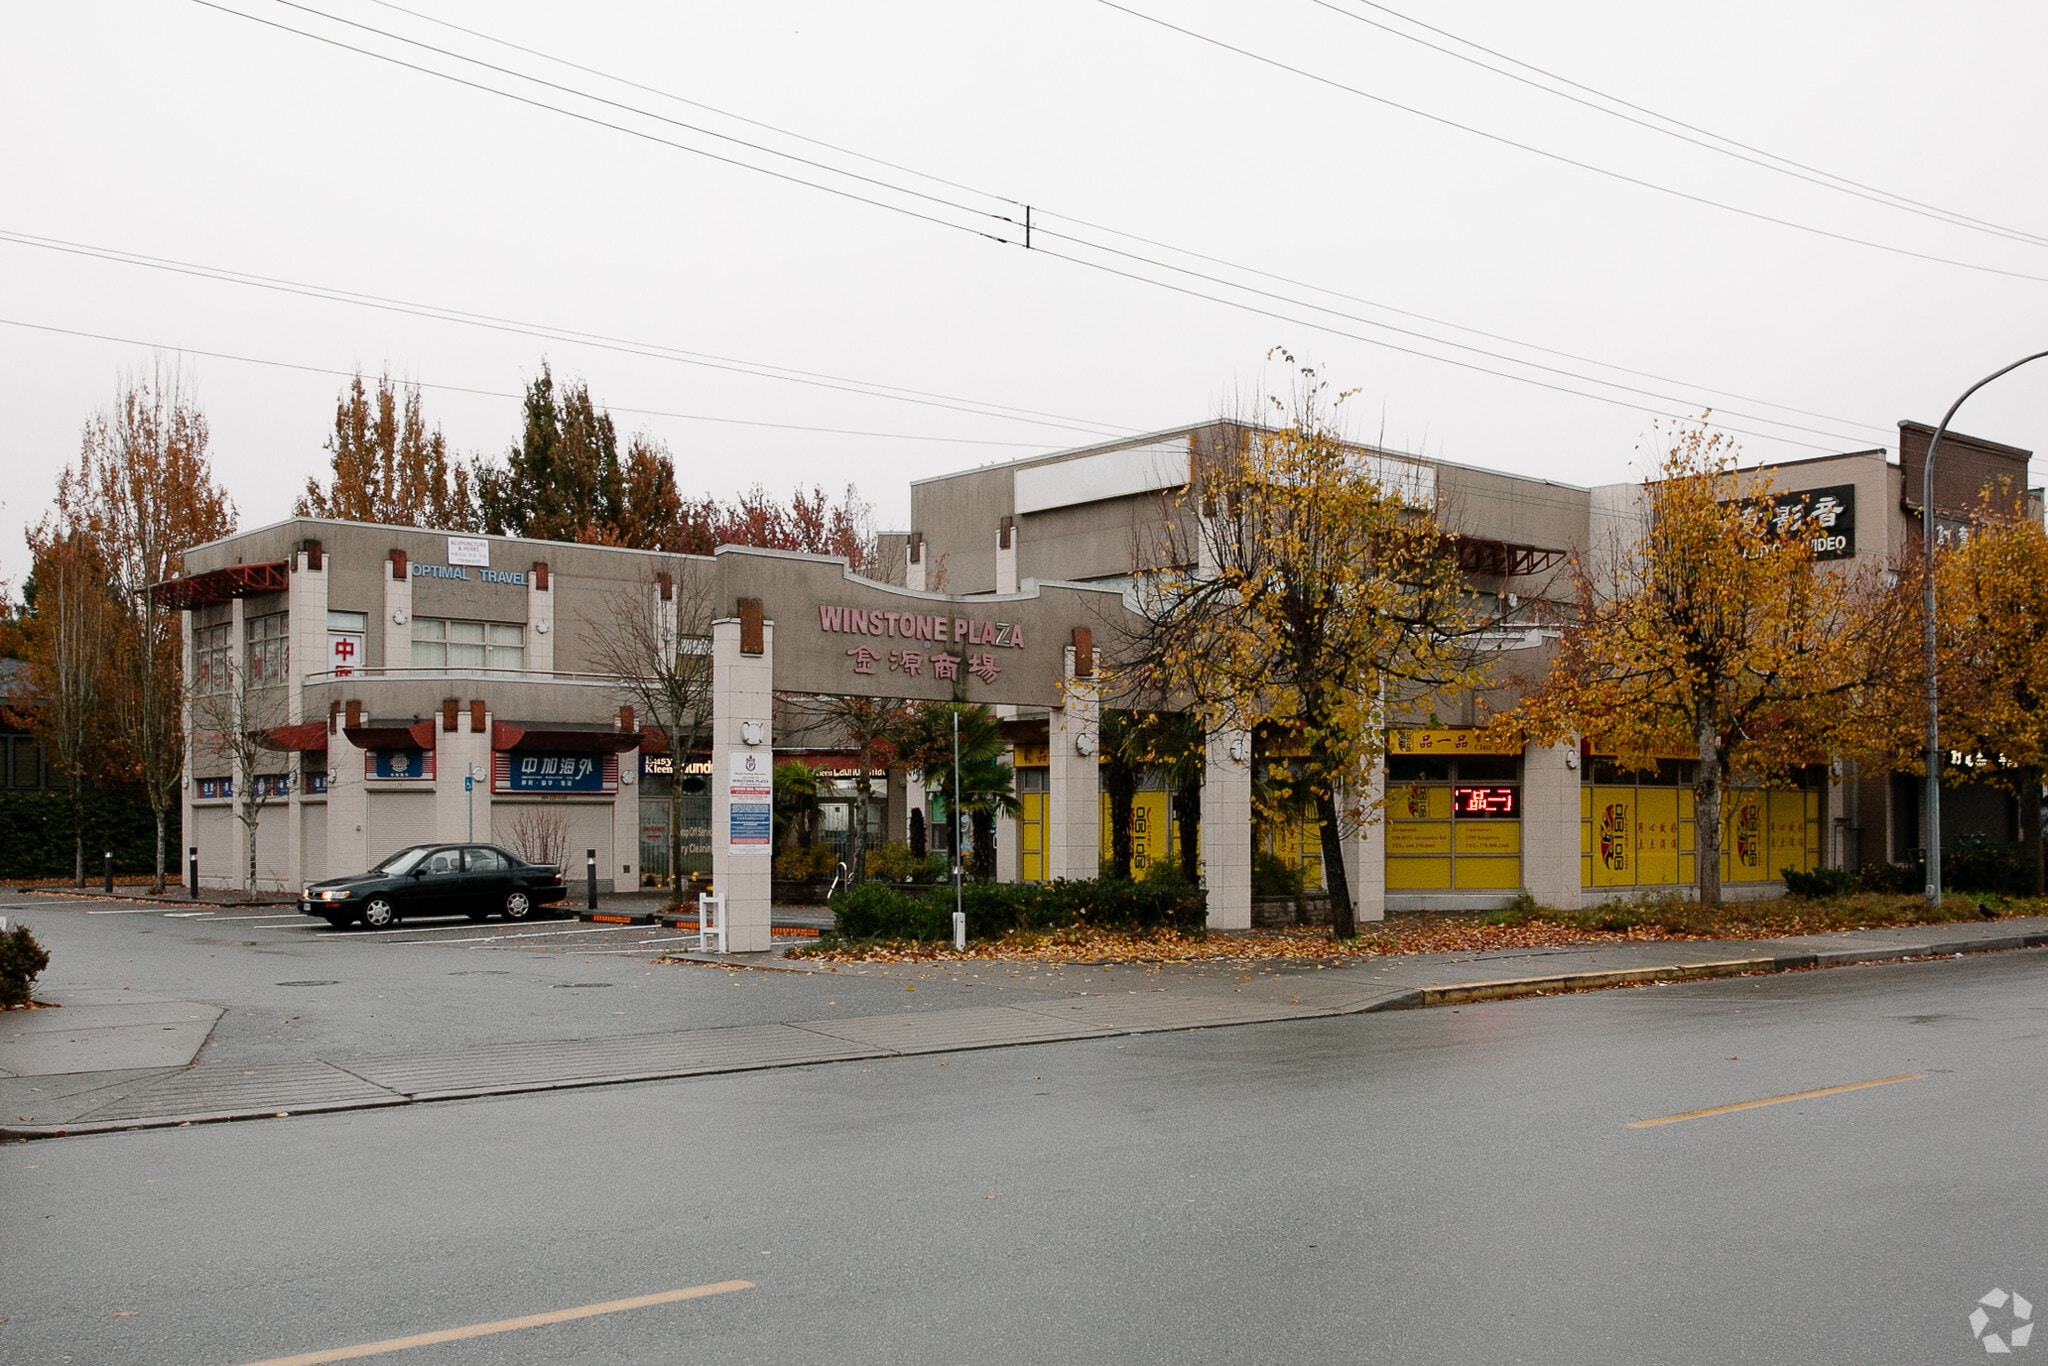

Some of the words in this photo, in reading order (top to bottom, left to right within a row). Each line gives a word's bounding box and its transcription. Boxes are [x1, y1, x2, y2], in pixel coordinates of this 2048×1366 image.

[450, 540, 487, 548] ACUPUNCTURE
[412, 563, 470, 581] OPTIMAL
[480, 569, 528, 585] TRAVEL
[818, 605, 947, 642] WINSTONE
[954, 618, 1024, 648] PLAZA
[846, 644, 1001, 684] 金源商場
[1419, 734, 1468, 749] 品一品
[521, 757, 593, 780] 中加海外
[645, 756, 673, 767] Easy
[645, 764, 674, 774] Kleen
